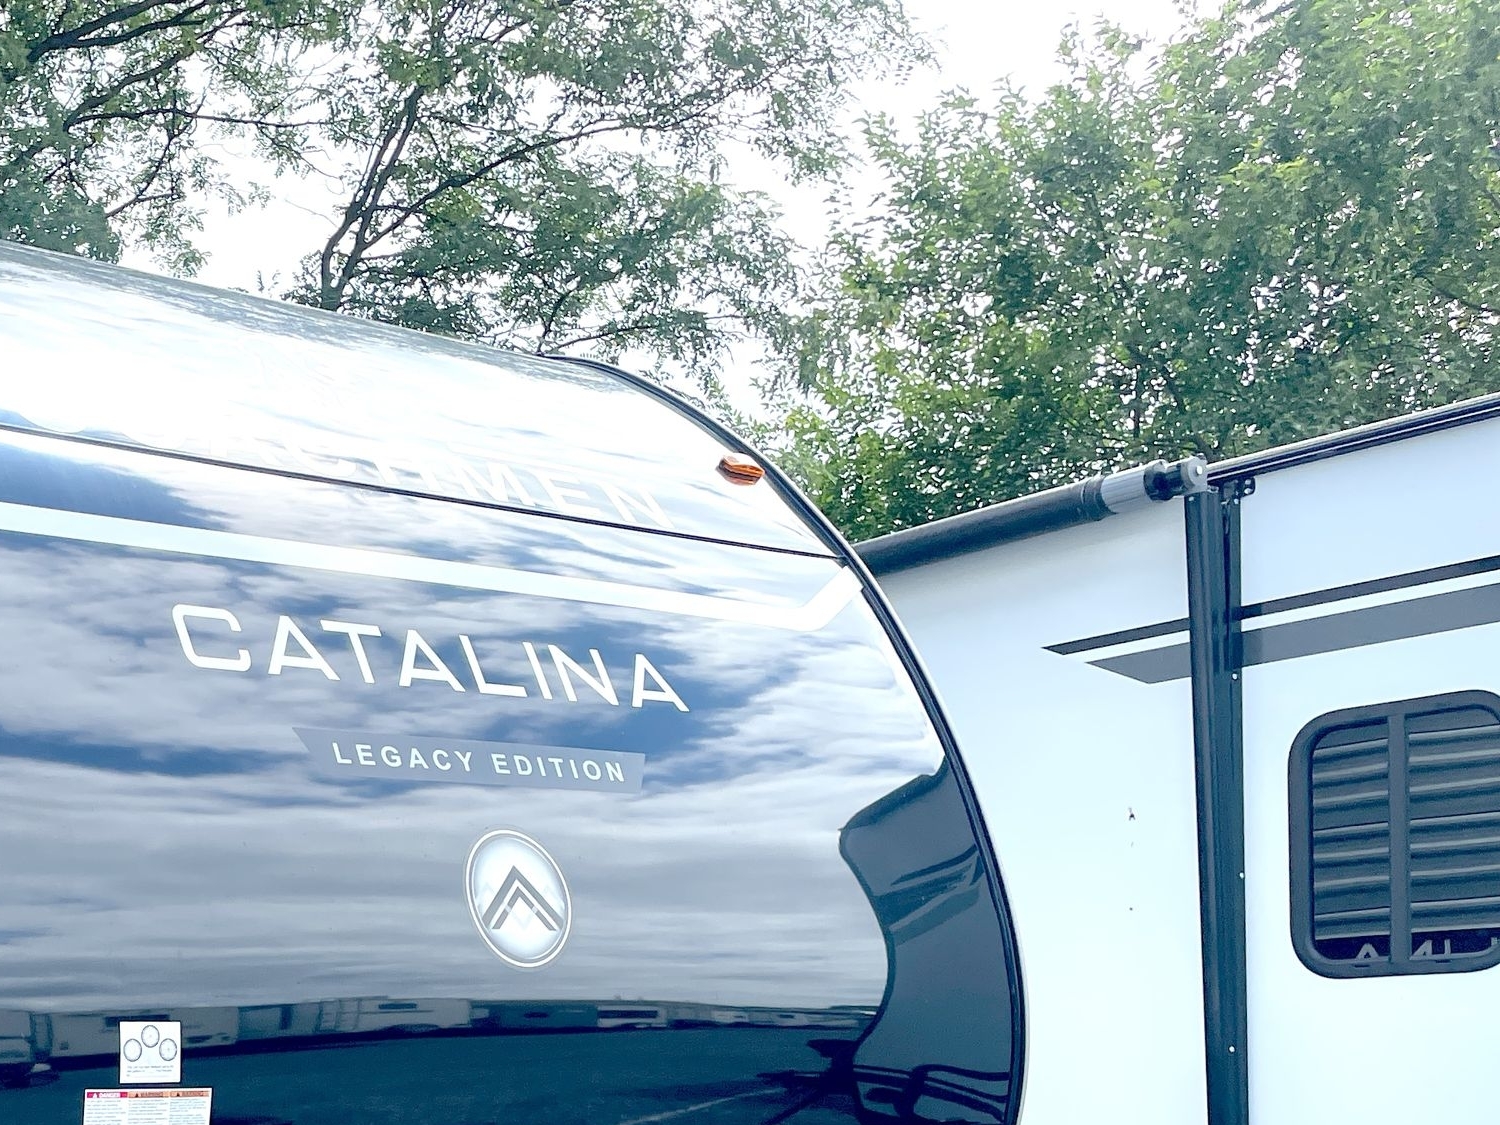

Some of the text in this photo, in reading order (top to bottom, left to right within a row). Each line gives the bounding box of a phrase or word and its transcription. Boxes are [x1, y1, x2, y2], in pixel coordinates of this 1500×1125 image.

[172, 604, 690, 712] CATALINA
[332, 742, 626, 783] LEGACY EDITION
